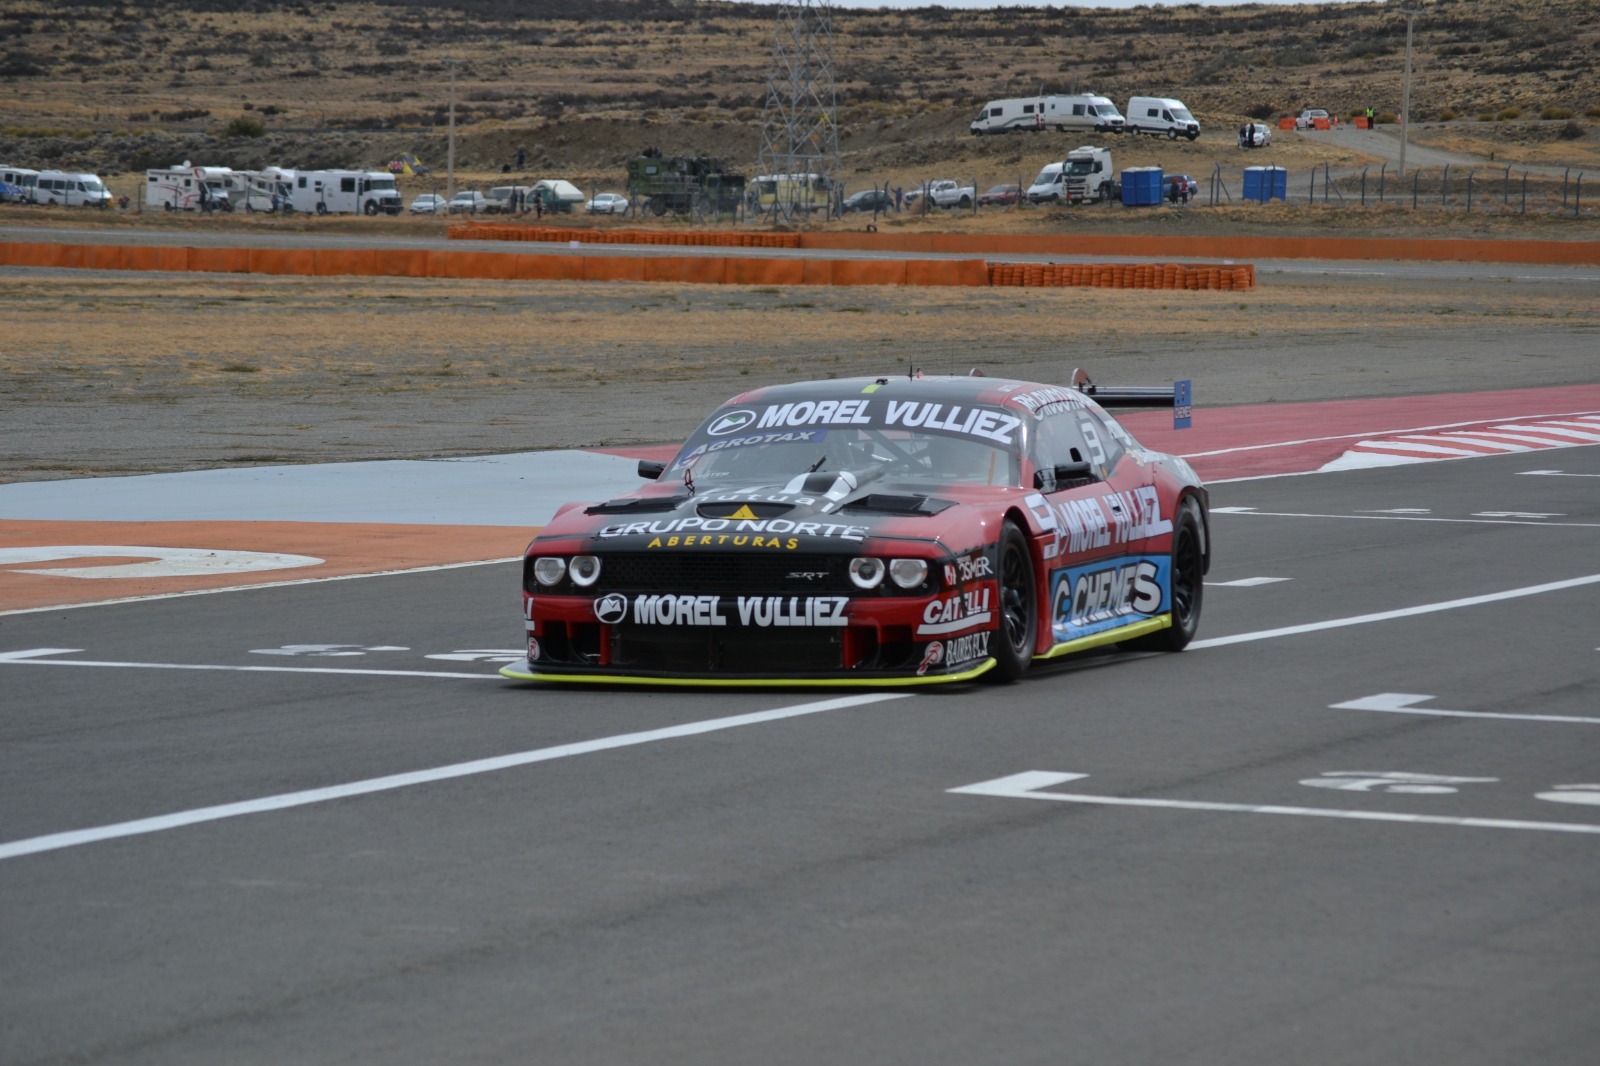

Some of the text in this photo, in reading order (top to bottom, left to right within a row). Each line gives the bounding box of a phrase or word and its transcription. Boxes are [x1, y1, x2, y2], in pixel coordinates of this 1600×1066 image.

[756, 400, 872, 428] MOREL
[885, 400, 1022, 445] VULLIEZ
[686, 431, 817, 460] AGROTAX
[599, 517, 871, 543] GRUPO NORTE
[1058, 497, 1111, 554] MOREL
[647, 535, 799, 550] ABERTURAS
[785, 572, 830, 581] SRT
[634, 594, 850, 627] MOREL VULLIEZ
